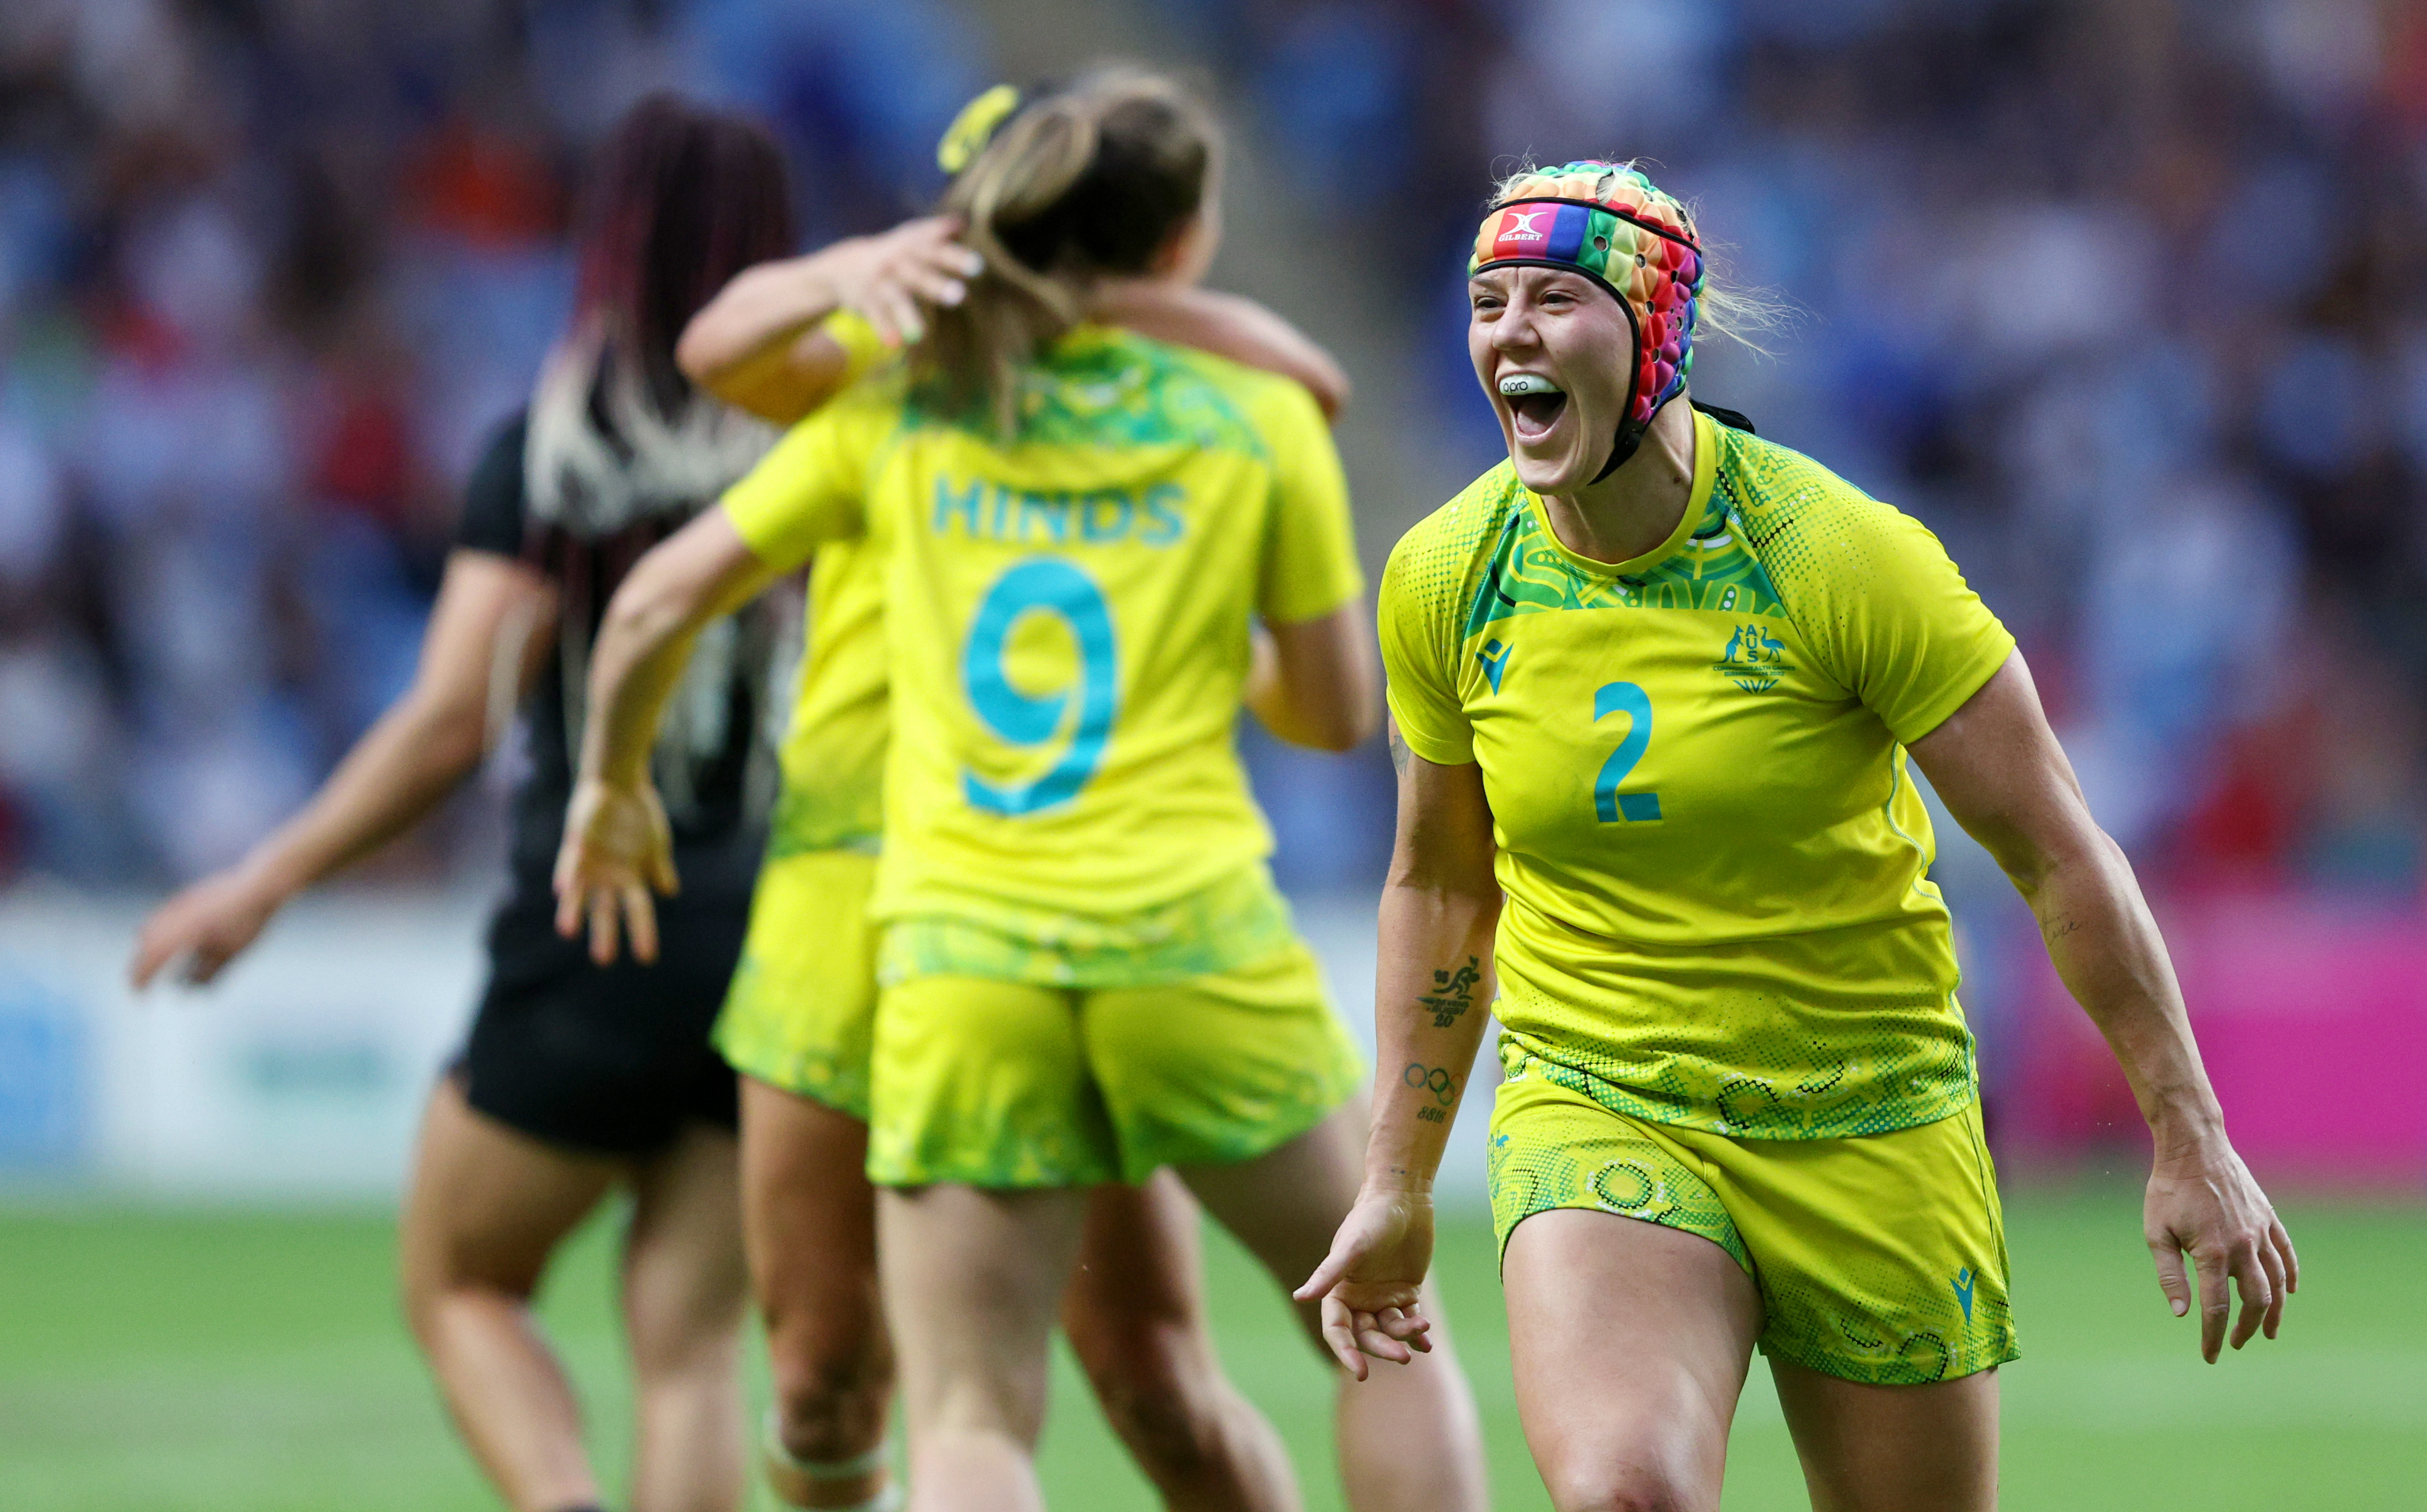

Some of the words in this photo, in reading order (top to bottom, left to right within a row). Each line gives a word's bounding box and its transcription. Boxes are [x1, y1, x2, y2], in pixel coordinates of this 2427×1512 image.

[1498, 233, 1543, 242] GILBERT
[930, 474, 1189, 549] HINDS
[1745, 624, 1758, 663] AUS
[962, 553, 1119, 816] 9
[1594, 681, 1662, 822] 2
